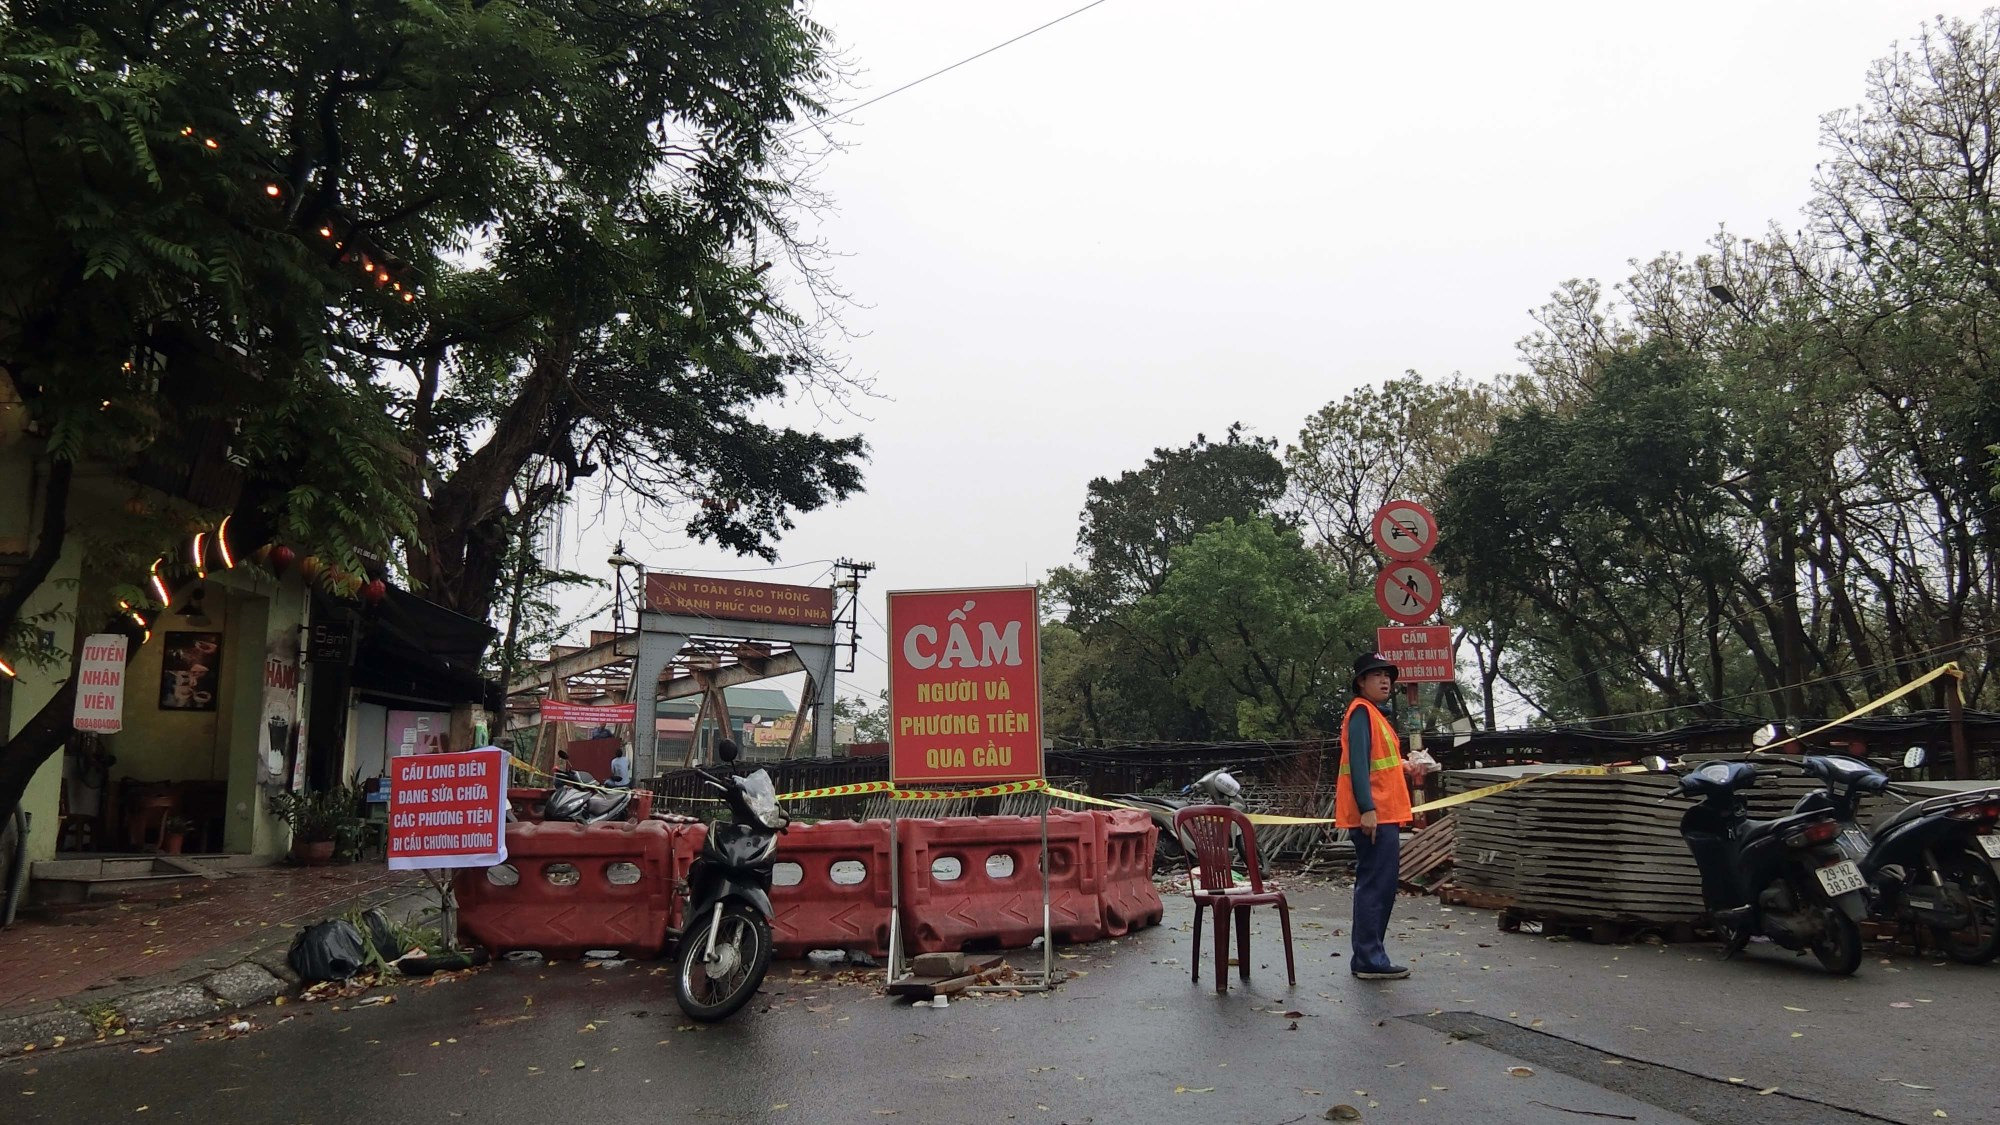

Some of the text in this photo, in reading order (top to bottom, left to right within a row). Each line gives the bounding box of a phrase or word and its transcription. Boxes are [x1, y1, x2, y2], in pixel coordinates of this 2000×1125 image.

[669, 581, 811, 602] AN TOÀN GIAO THÔNG
[656, 593, 672, 606] LÀ
[715, 598, 744, 612] PHÚC
[750, 604, 772, 615] CHO
[777, 605, 800, 619] MỌI
[804, 607, 828, 619] NHÀ
[903, 600, 1023, 670] CẤM
[1401, 629, 1428, 644] CẤM
[84, 640, 125, 662] TUYỂN
[1417, 650, 1425, 660] XE
[82, 668, 120, 686] NHÂN
[1425, 666, 1433, 677] 20
[917, 677, 1010, 703] NGƯỜI VÀ
[83, 692, 115, 710] VIÊN
[900, 710, 1029, 737] PHƯƠNG TIỆN
[926, 740, 1012, 770] QUA CẦU
[426, 763, 455, 779] LONG
[458, 760, 487, 777] BIÊN
[398, 783, 489, 805] ĐANG SỬA CHỮA
[393, 807, 493, 828] CÁC PHƯƠNG TIỆN
[393, 836, 403, 852] ĐI
[423, 834, 460, 850] CHƯƠNG
[461, 832, 493, 848] DƯƠNG
[1823, 863, 1854, 882] 29-HZ
[1826, 873, 1863, 894] 383.85
